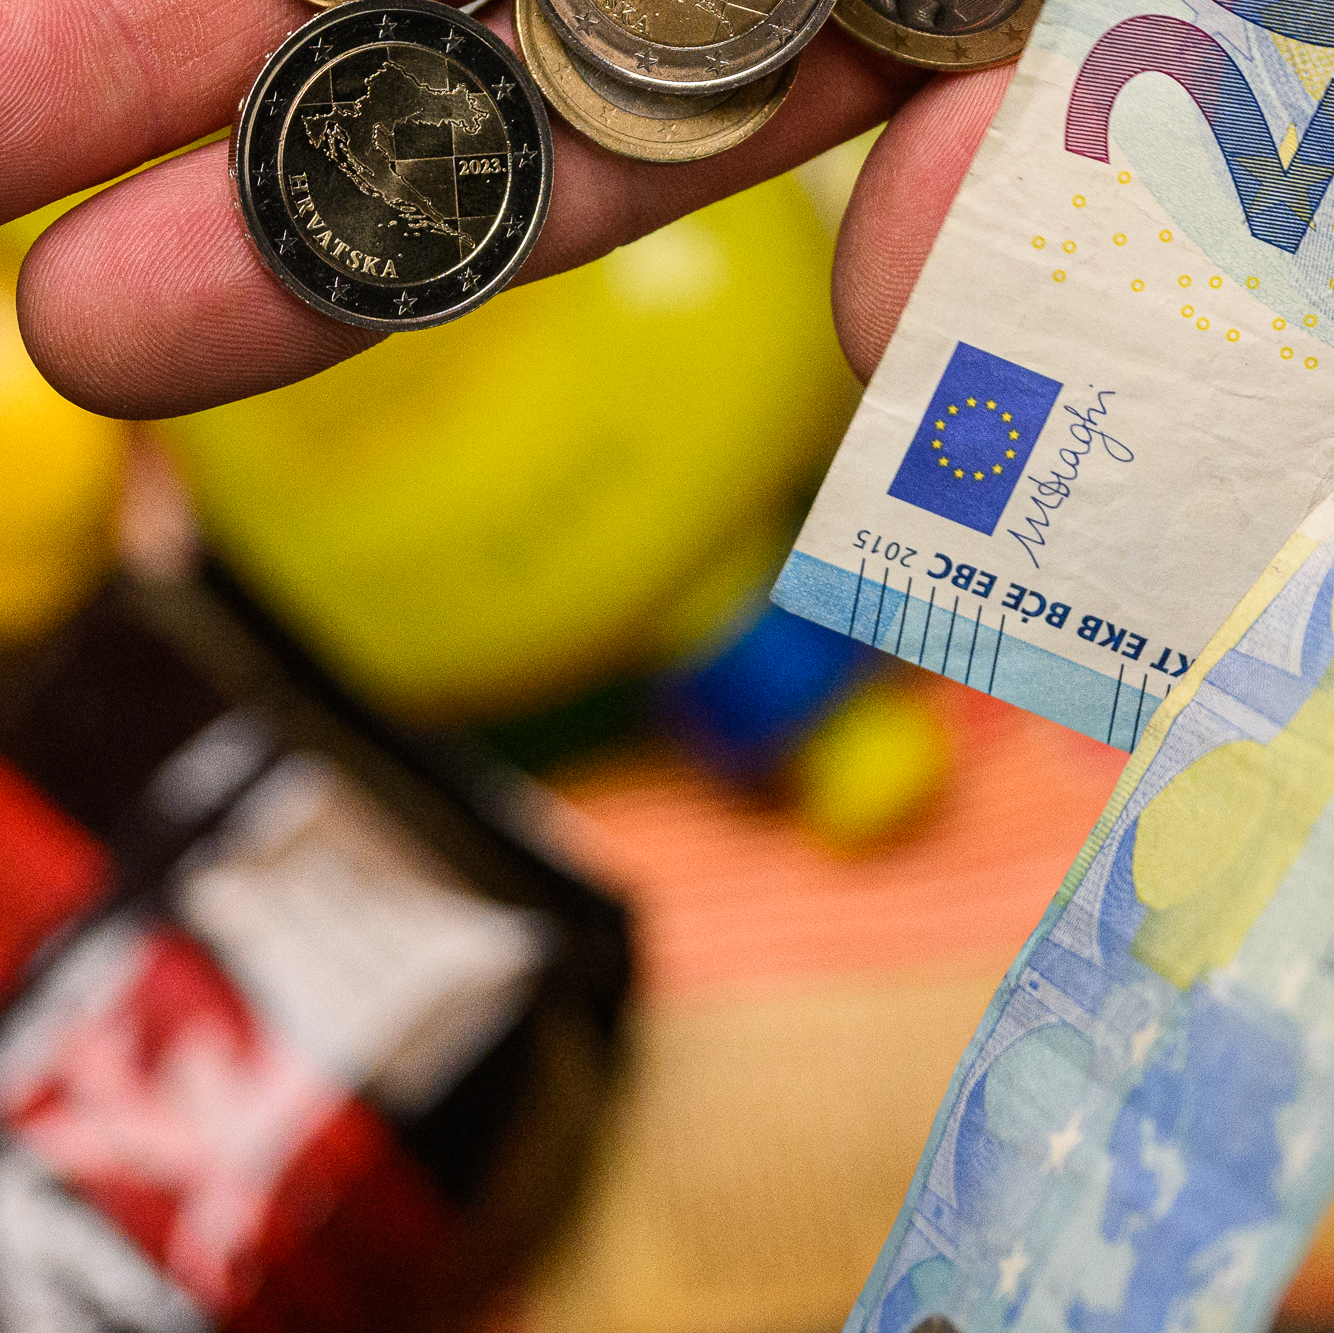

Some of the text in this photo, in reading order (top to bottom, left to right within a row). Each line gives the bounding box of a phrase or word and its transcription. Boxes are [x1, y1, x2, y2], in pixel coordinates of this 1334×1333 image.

[457, 156, 508, 178] 2023.
[286, 170, 401, 281] HRVATSKA
[852, 528, 918, 568] 2015
[926, 552, 998, 600] EBC
[1076, 614, 1149, 662] EKB
[1148, 646, 1196, 678] KT
